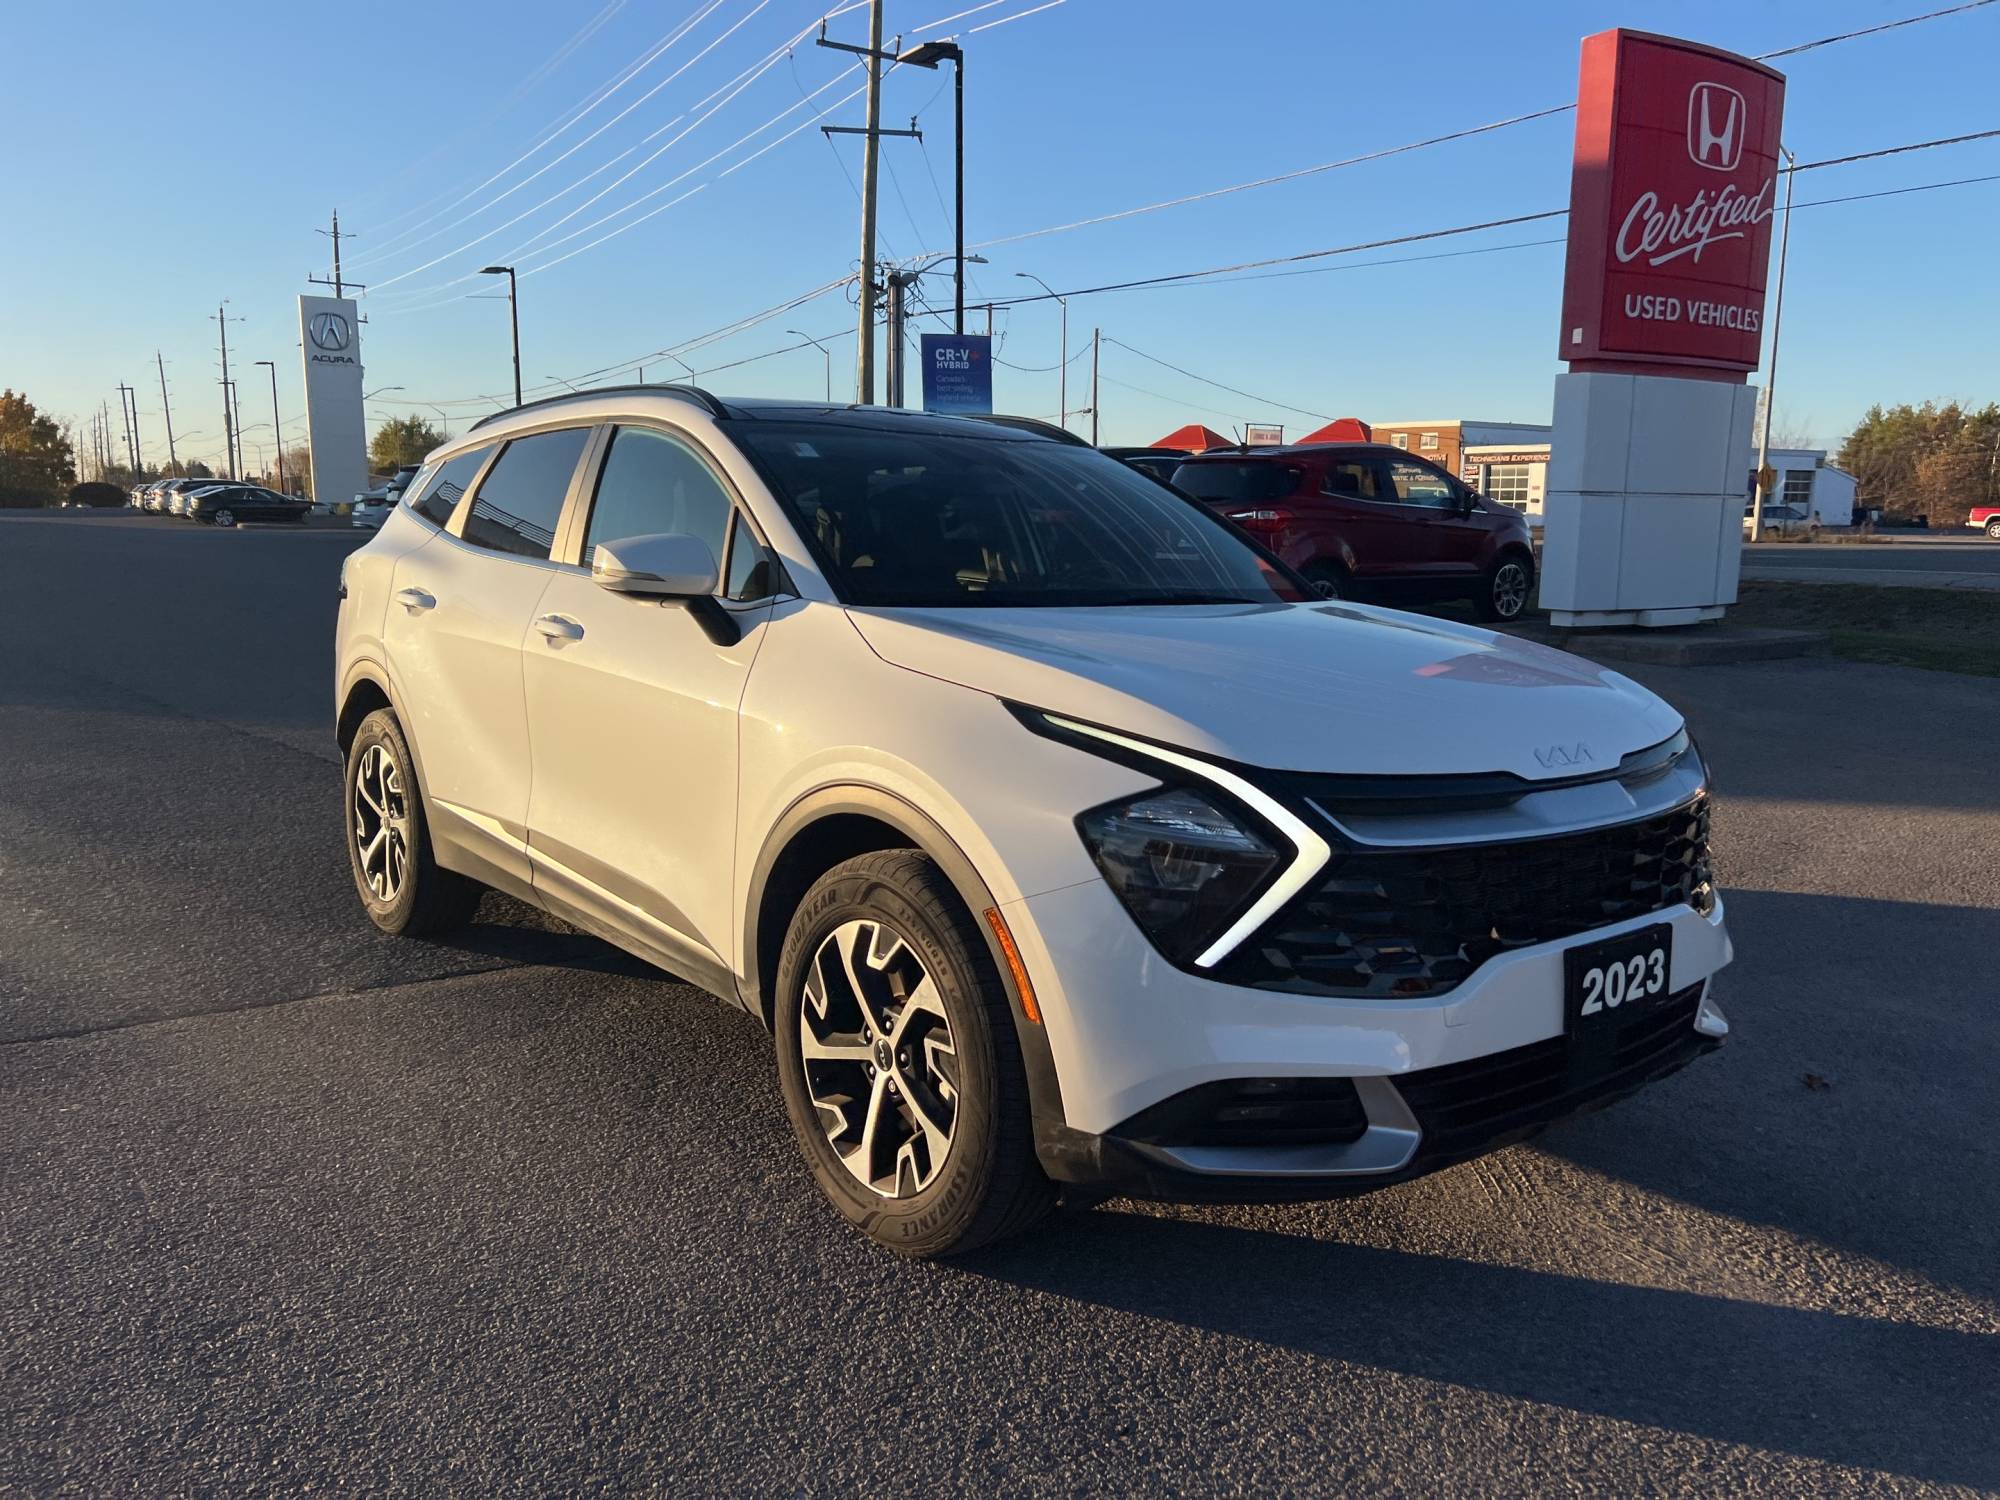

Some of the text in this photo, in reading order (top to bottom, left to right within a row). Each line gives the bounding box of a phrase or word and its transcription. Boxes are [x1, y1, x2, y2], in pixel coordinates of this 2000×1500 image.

[1615, 178, 1773, 266] Certified
[1625, 294, 1759, 332] USED VEHICLES
[311, 354, 354, 364] ACURA
[936, 348, 969, 361] CR-V
[936, 360, 970, 369] HYBRID
[782, 888, 837, 978] GOODYEAR
[1581, 948, 1665, 1016] 2023
